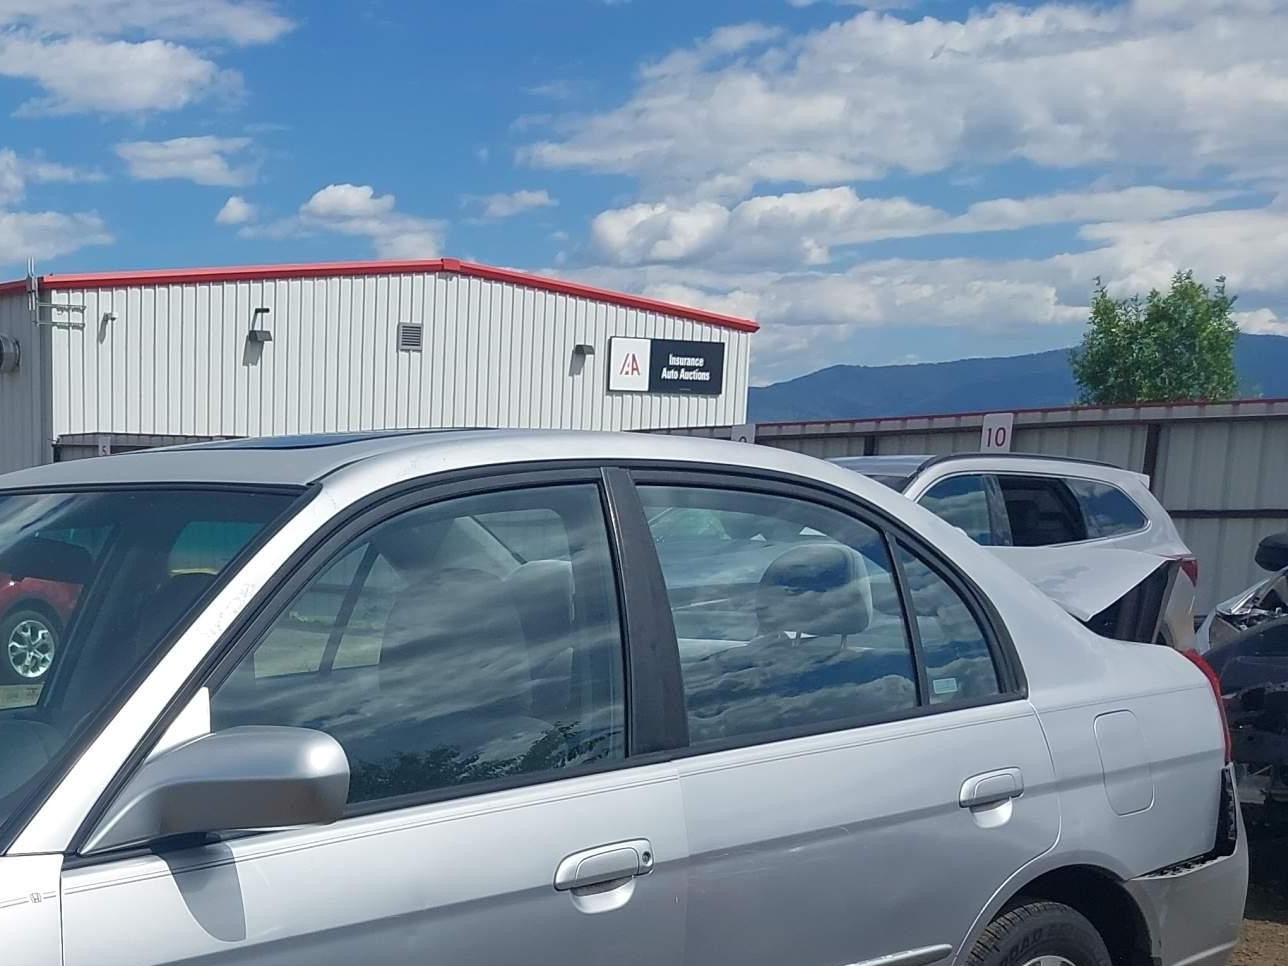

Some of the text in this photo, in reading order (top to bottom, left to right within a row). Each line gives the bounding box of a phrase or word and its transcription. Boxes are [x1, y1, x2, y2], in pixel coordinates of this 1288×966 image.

[668, 354, 705, 367] Insurance
[661, 367, 711, 381] Auto Auctions
[986, 427, 1007, 448] 10
